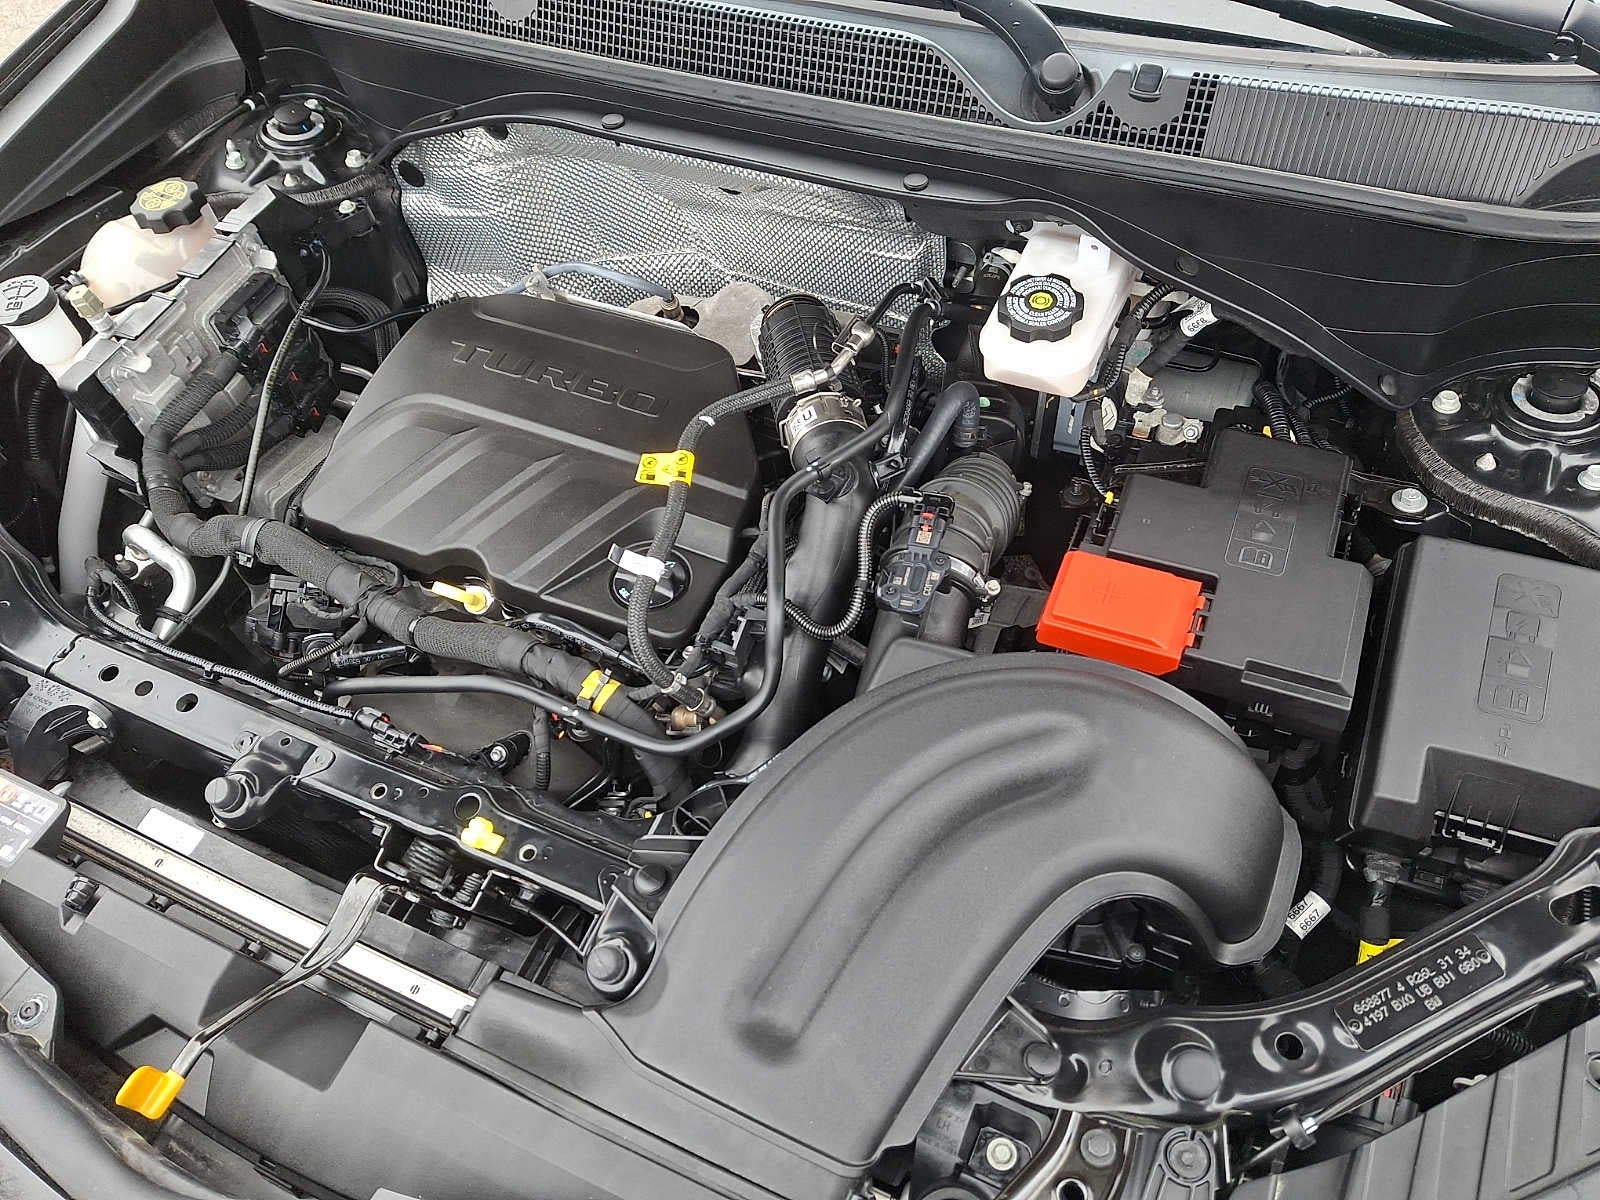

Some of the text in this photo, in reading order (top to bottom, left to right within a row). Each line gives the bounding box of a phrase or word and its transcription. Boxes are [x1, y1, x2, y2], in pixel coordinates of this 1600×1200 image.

[451, 341, 669, 418] TURBO
[1300, 908, 1320, 931] 6667
[1436, 955, 1454, 970] 31
[1454, 945, 1472, 960] 34
[1363, 1006, 1389, 1027] 4197
